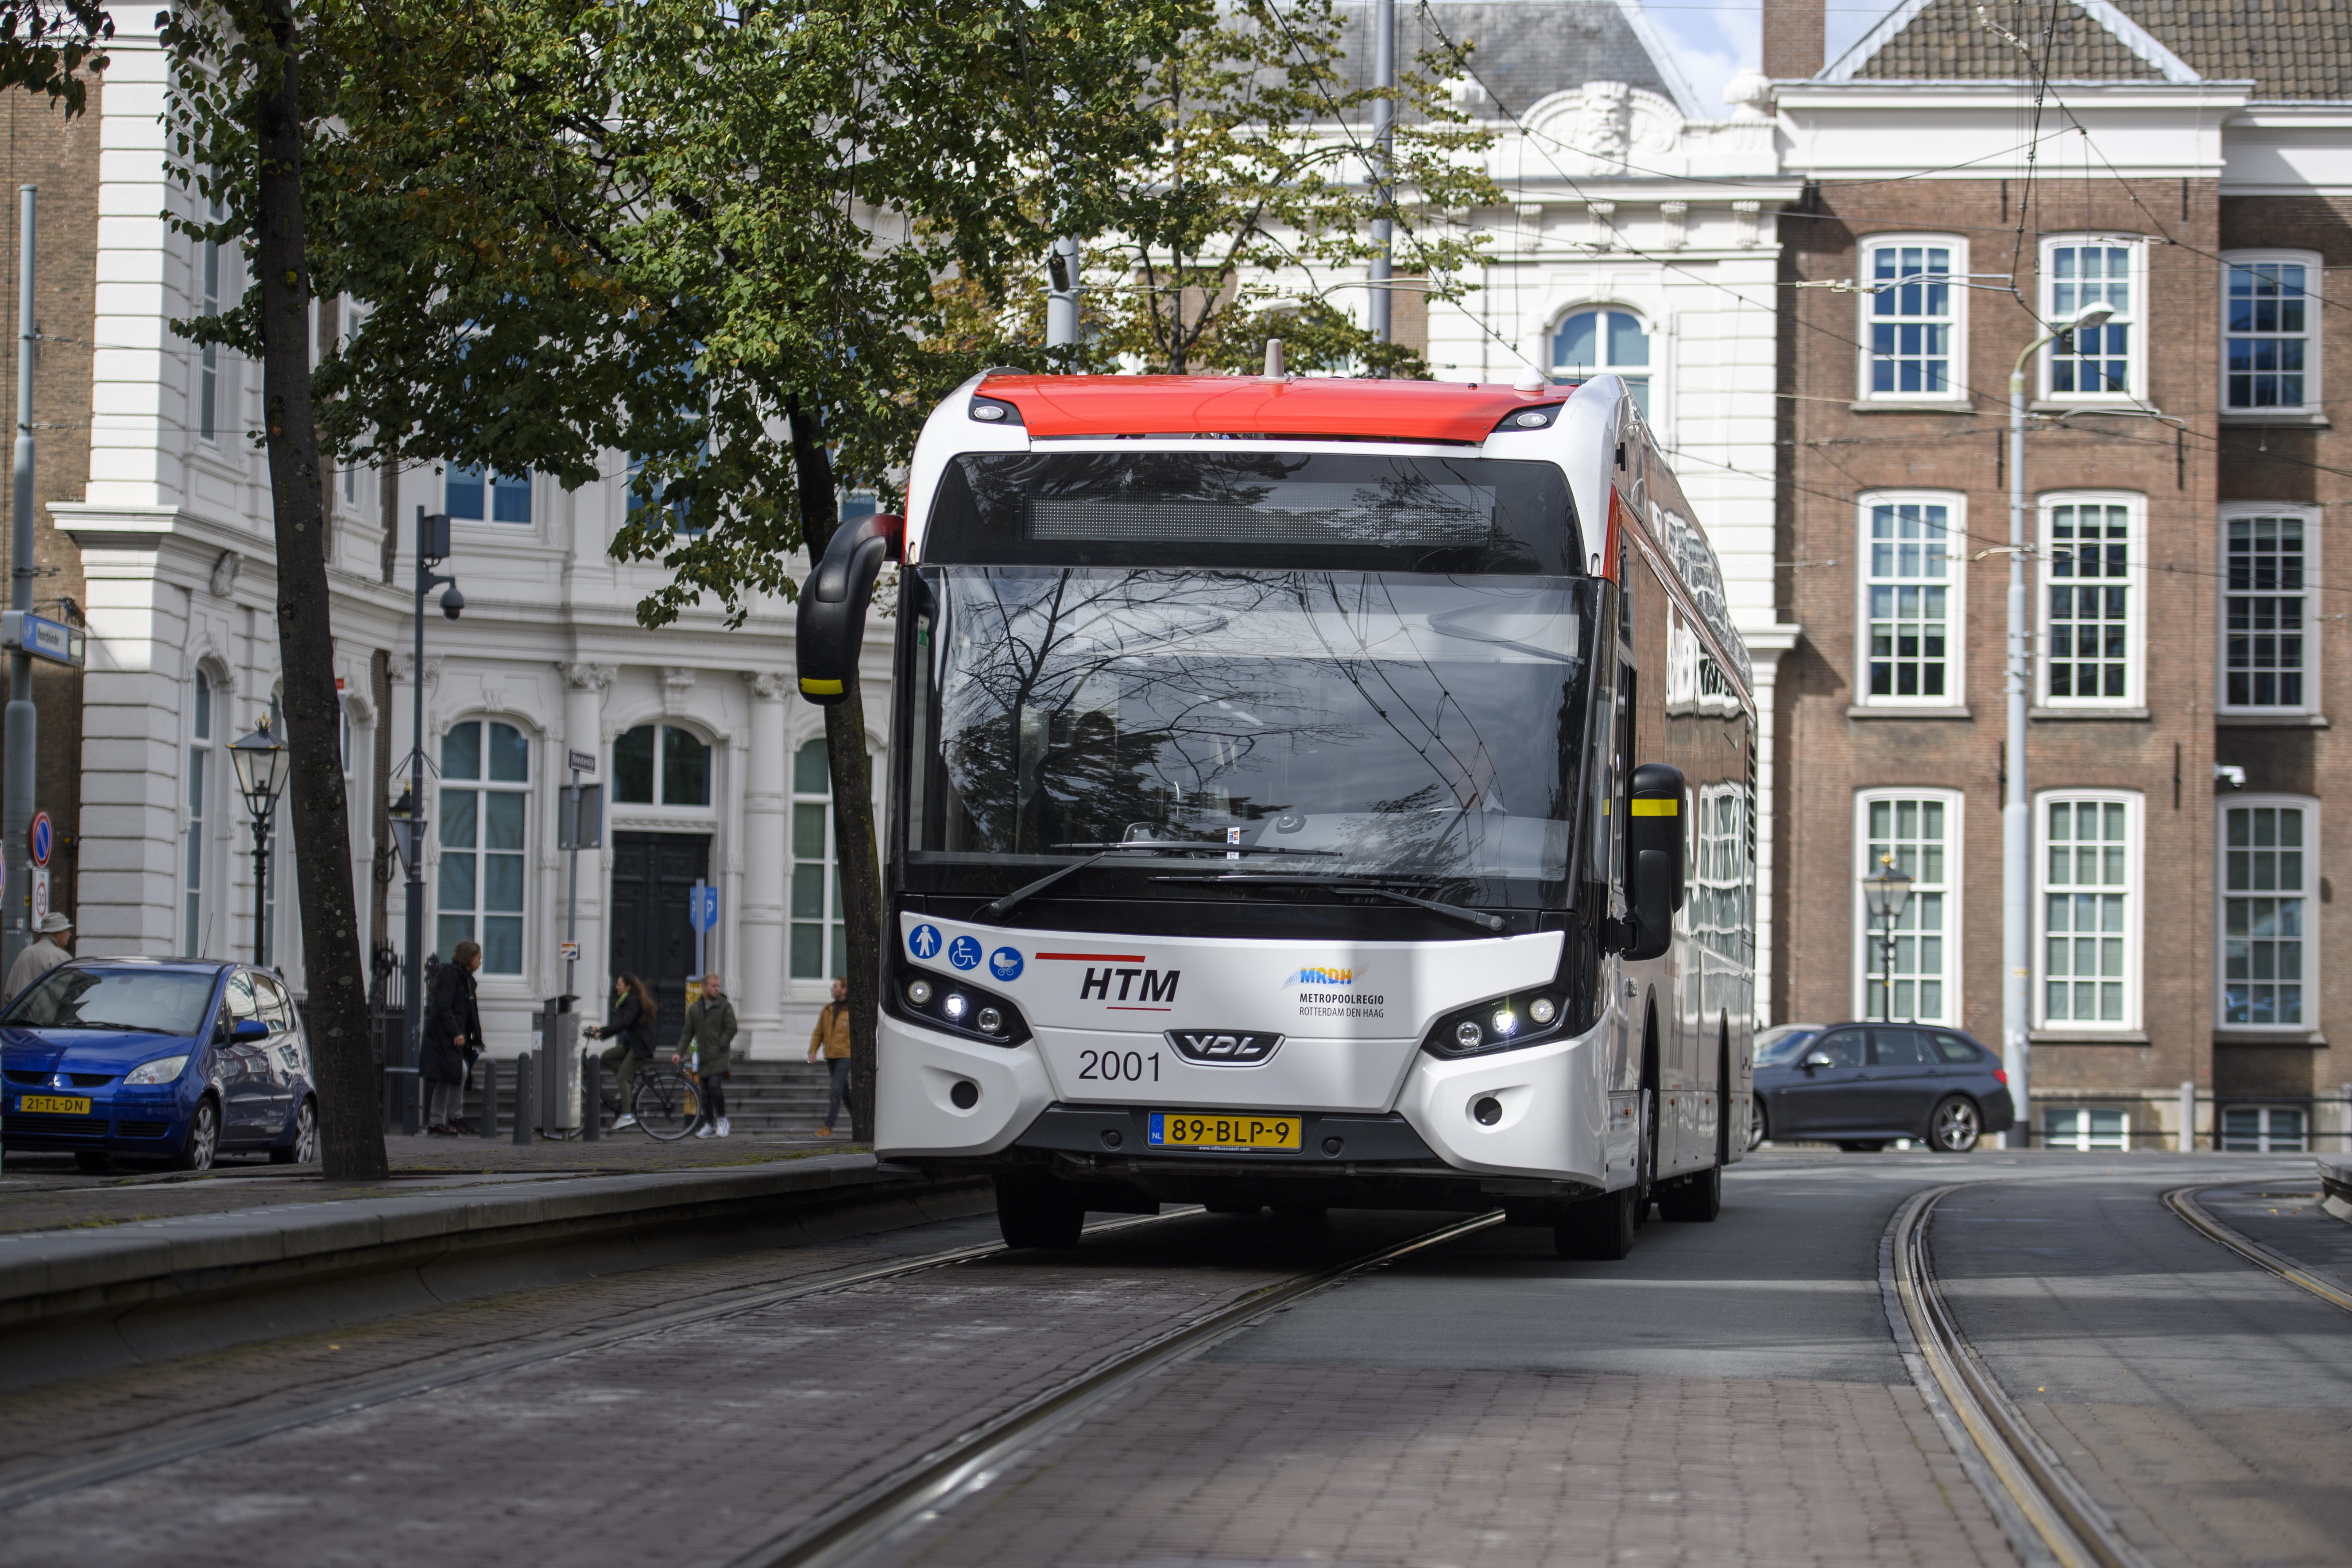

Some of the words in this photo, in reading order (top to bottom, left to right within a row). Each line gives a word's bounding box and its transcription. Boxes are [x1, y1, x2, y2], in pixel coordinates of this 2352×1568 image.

[573, 754, 594, 770] Kneuterdijk
[38, 893, 44, 906] 30
[707, 900, 713, 919] P
[1079, 968, 1180, 1002] HTM
[1300, 967, 1352, 985] MRDH
[1300, 993, 1384, 1005] METROPOOLREGIO
[1300, 1007, 1344, 1017] ROTTERDAM
[1346, 1008, 1361, 1017] DEN
[1363, 1009, 1384, 1018] HAAG
[1184, 1035, 1261, 1055] VDL
[1079, 1050, 1158, 1081] 2001
[27, 1098, 83, 1111] 21-TL-DN
[1172, 1119, 1289, 1143] 89-BLP-9
